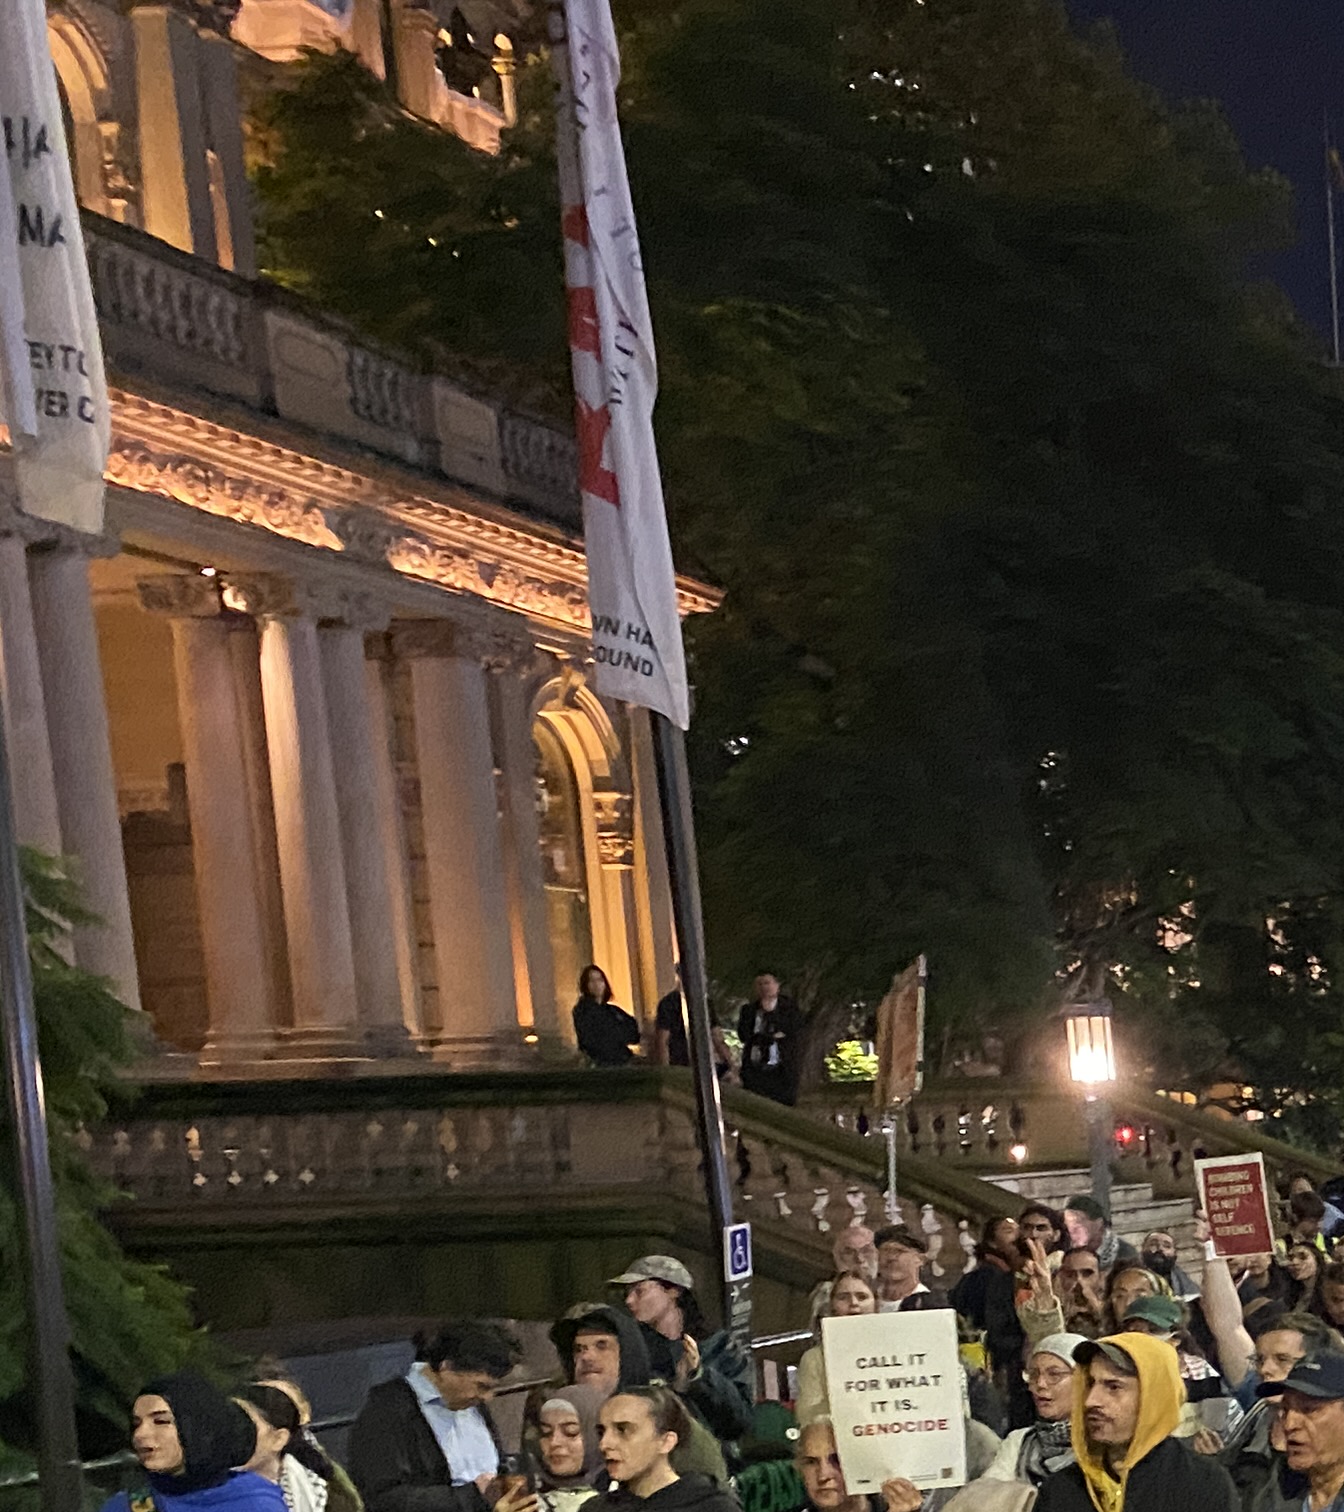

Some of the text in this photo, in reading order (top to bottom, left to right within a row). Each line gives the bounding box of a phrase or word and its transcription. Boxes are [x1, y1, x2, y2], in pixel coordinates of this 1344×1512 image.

[855, 1353, 927, 1369] CALL IT
[844, 1374, 943, 1393] FOR WHAT
[870, 1401, 889, 1413] IT
[852, 1418, 950, 1437] GENOCIDE
